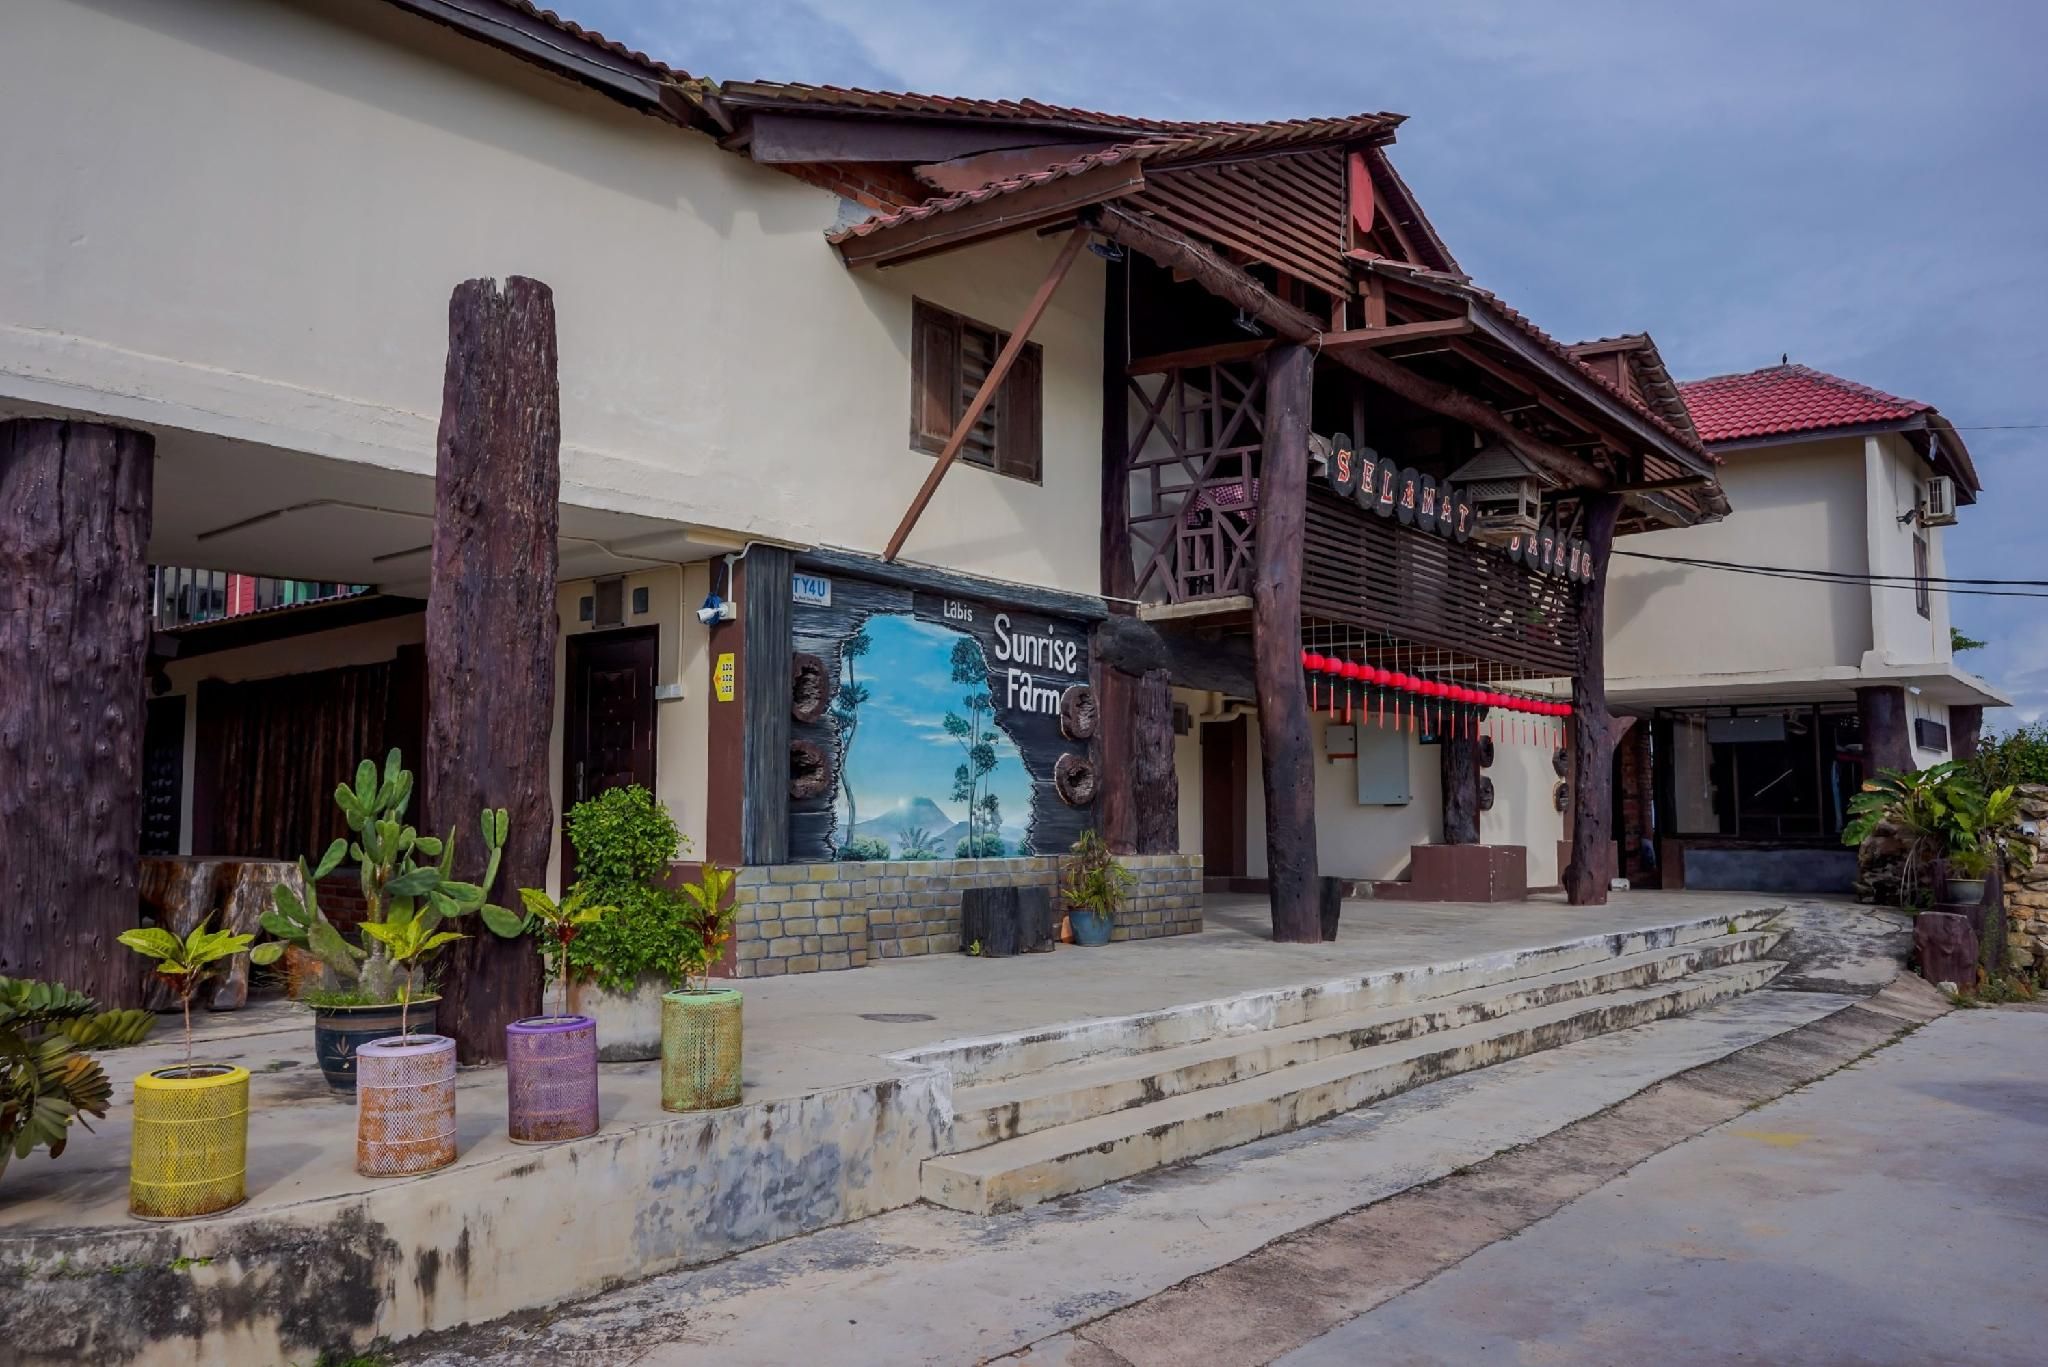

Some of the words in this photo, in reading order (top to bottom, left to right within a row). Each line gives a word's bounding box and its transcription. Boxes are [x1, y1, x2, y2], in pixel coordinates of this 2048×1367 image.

[1337, 448, 1469, 533] SELAMAT
[943, 599, 973, 622] Labis
[994, 613, 1077, 674] Sunrise
[1007, 667, 1060, 715] Farm
